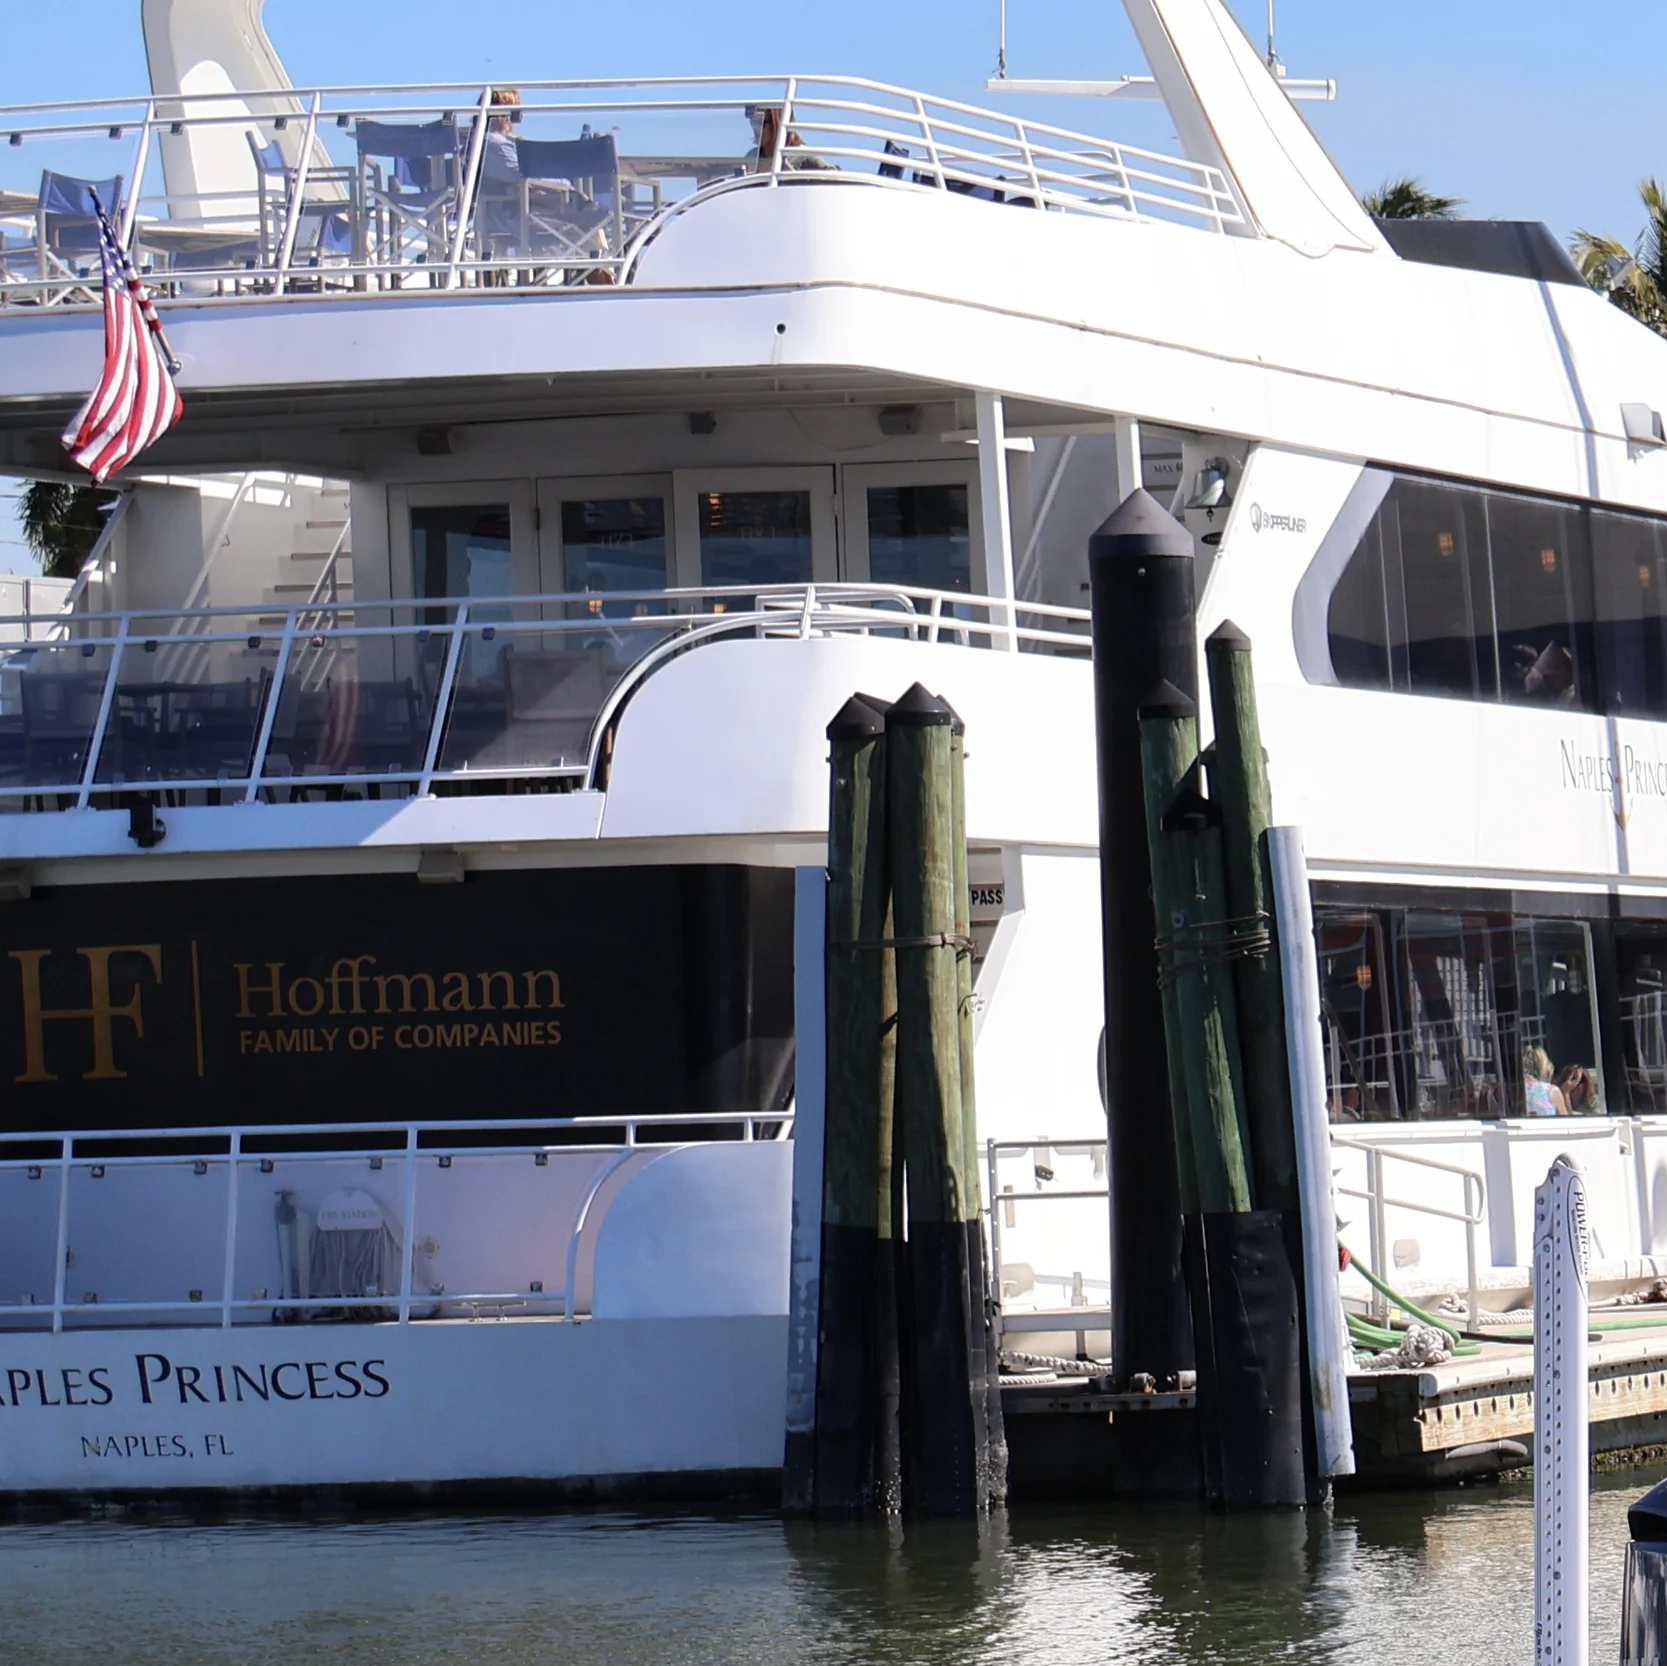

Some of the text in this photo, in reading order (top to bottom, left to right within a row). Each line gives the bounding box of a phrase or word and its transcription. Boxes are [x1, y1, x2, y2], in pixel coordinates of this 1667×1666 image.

[7, 943, 163, 1082] HF
[233, 954, 566, 1018] Hoffmann
[240, 1020, 562, 1054] FAMILY OF COMPANIES
[0, 1352, 391, 1407] PLES PRINCESS
[80, 1433, 234, 1459] NAPLES, FL
